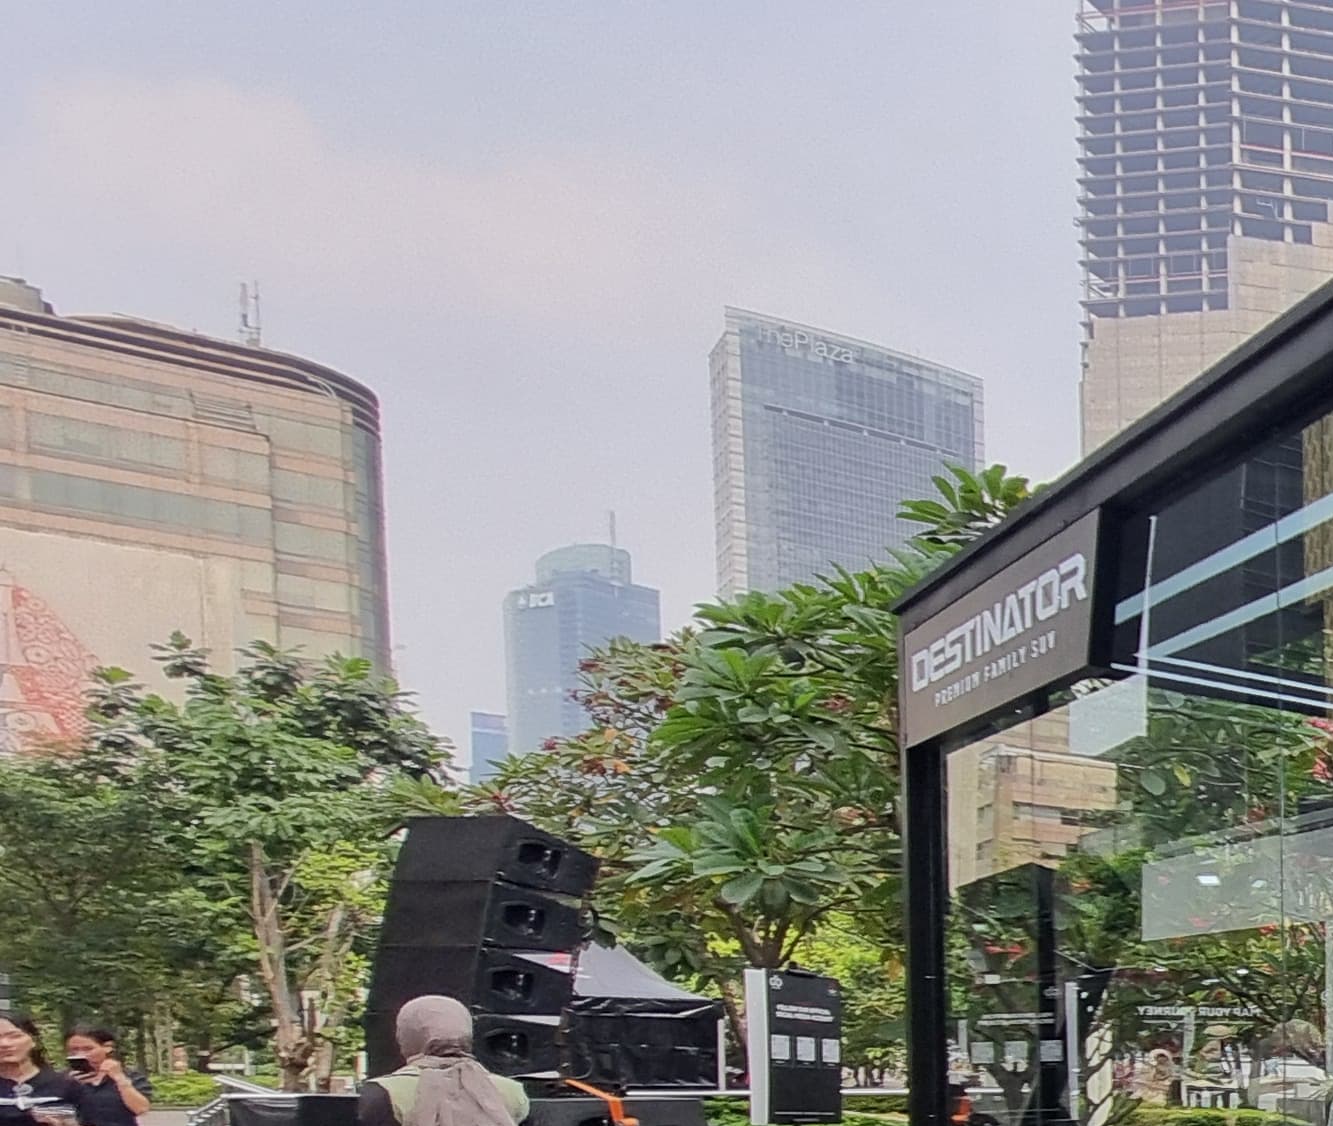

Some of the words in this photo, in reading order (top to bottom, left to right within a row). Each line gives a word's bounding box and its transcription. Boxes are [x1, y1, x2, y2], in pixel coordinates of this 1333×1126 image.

[911, 553, 1087, 692] DESTINATOR
[934, 671, 980, 707] PREMIUM
[983, 646, 1027, 682] FAMILY
[1030, 630, 1057, 658] SUV
